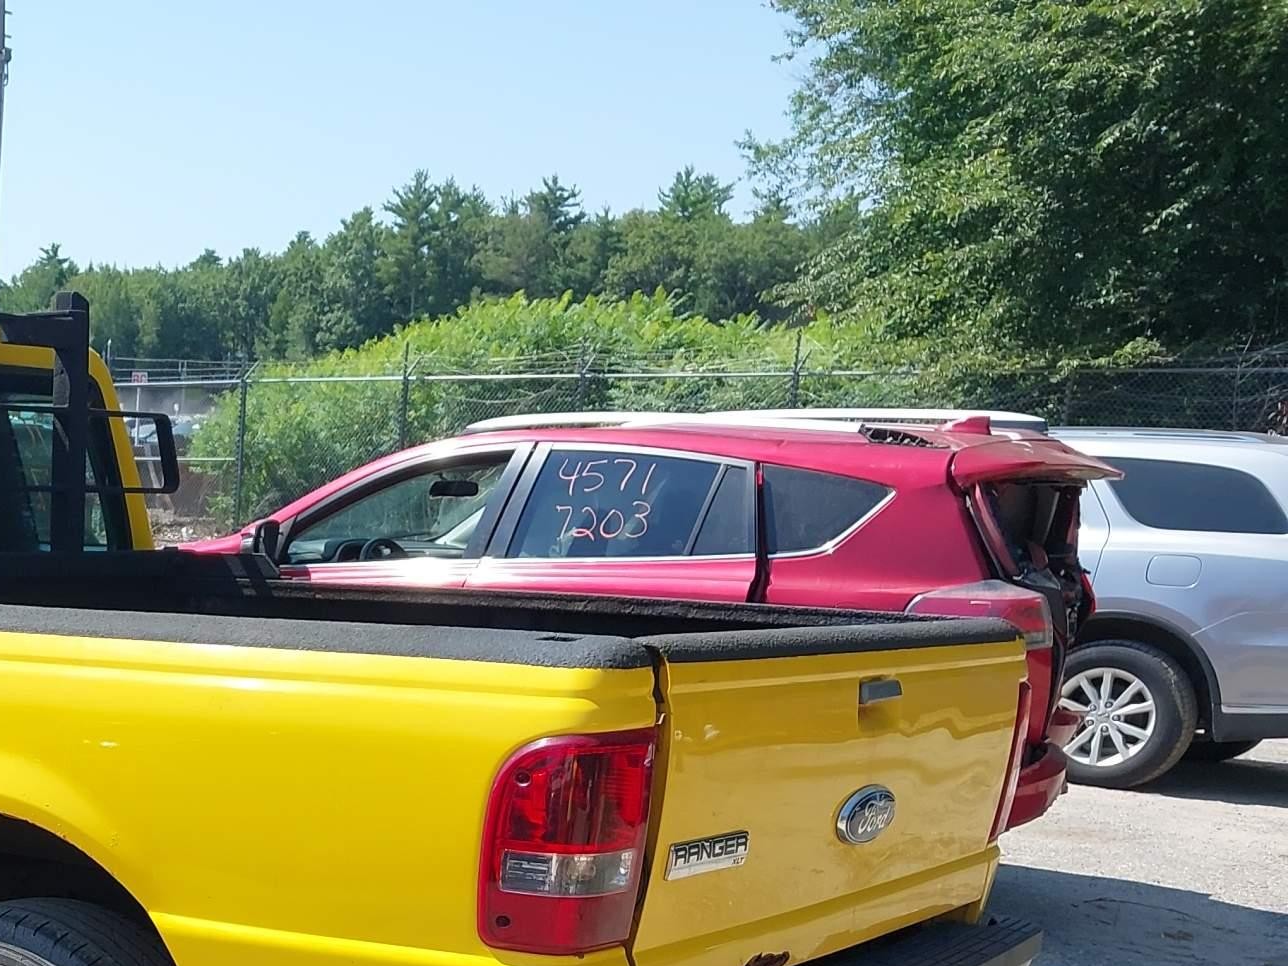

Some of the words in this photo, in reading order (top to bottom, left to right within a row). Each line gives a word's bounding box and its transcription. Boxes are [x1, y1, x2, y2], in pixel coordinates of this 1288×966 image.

[558, 457, 657, 496] 4571
[555, 500, 652, 541] 7203
[857, 800, 891, 834] Ford
[673, 834, 748, 867] RANGER
